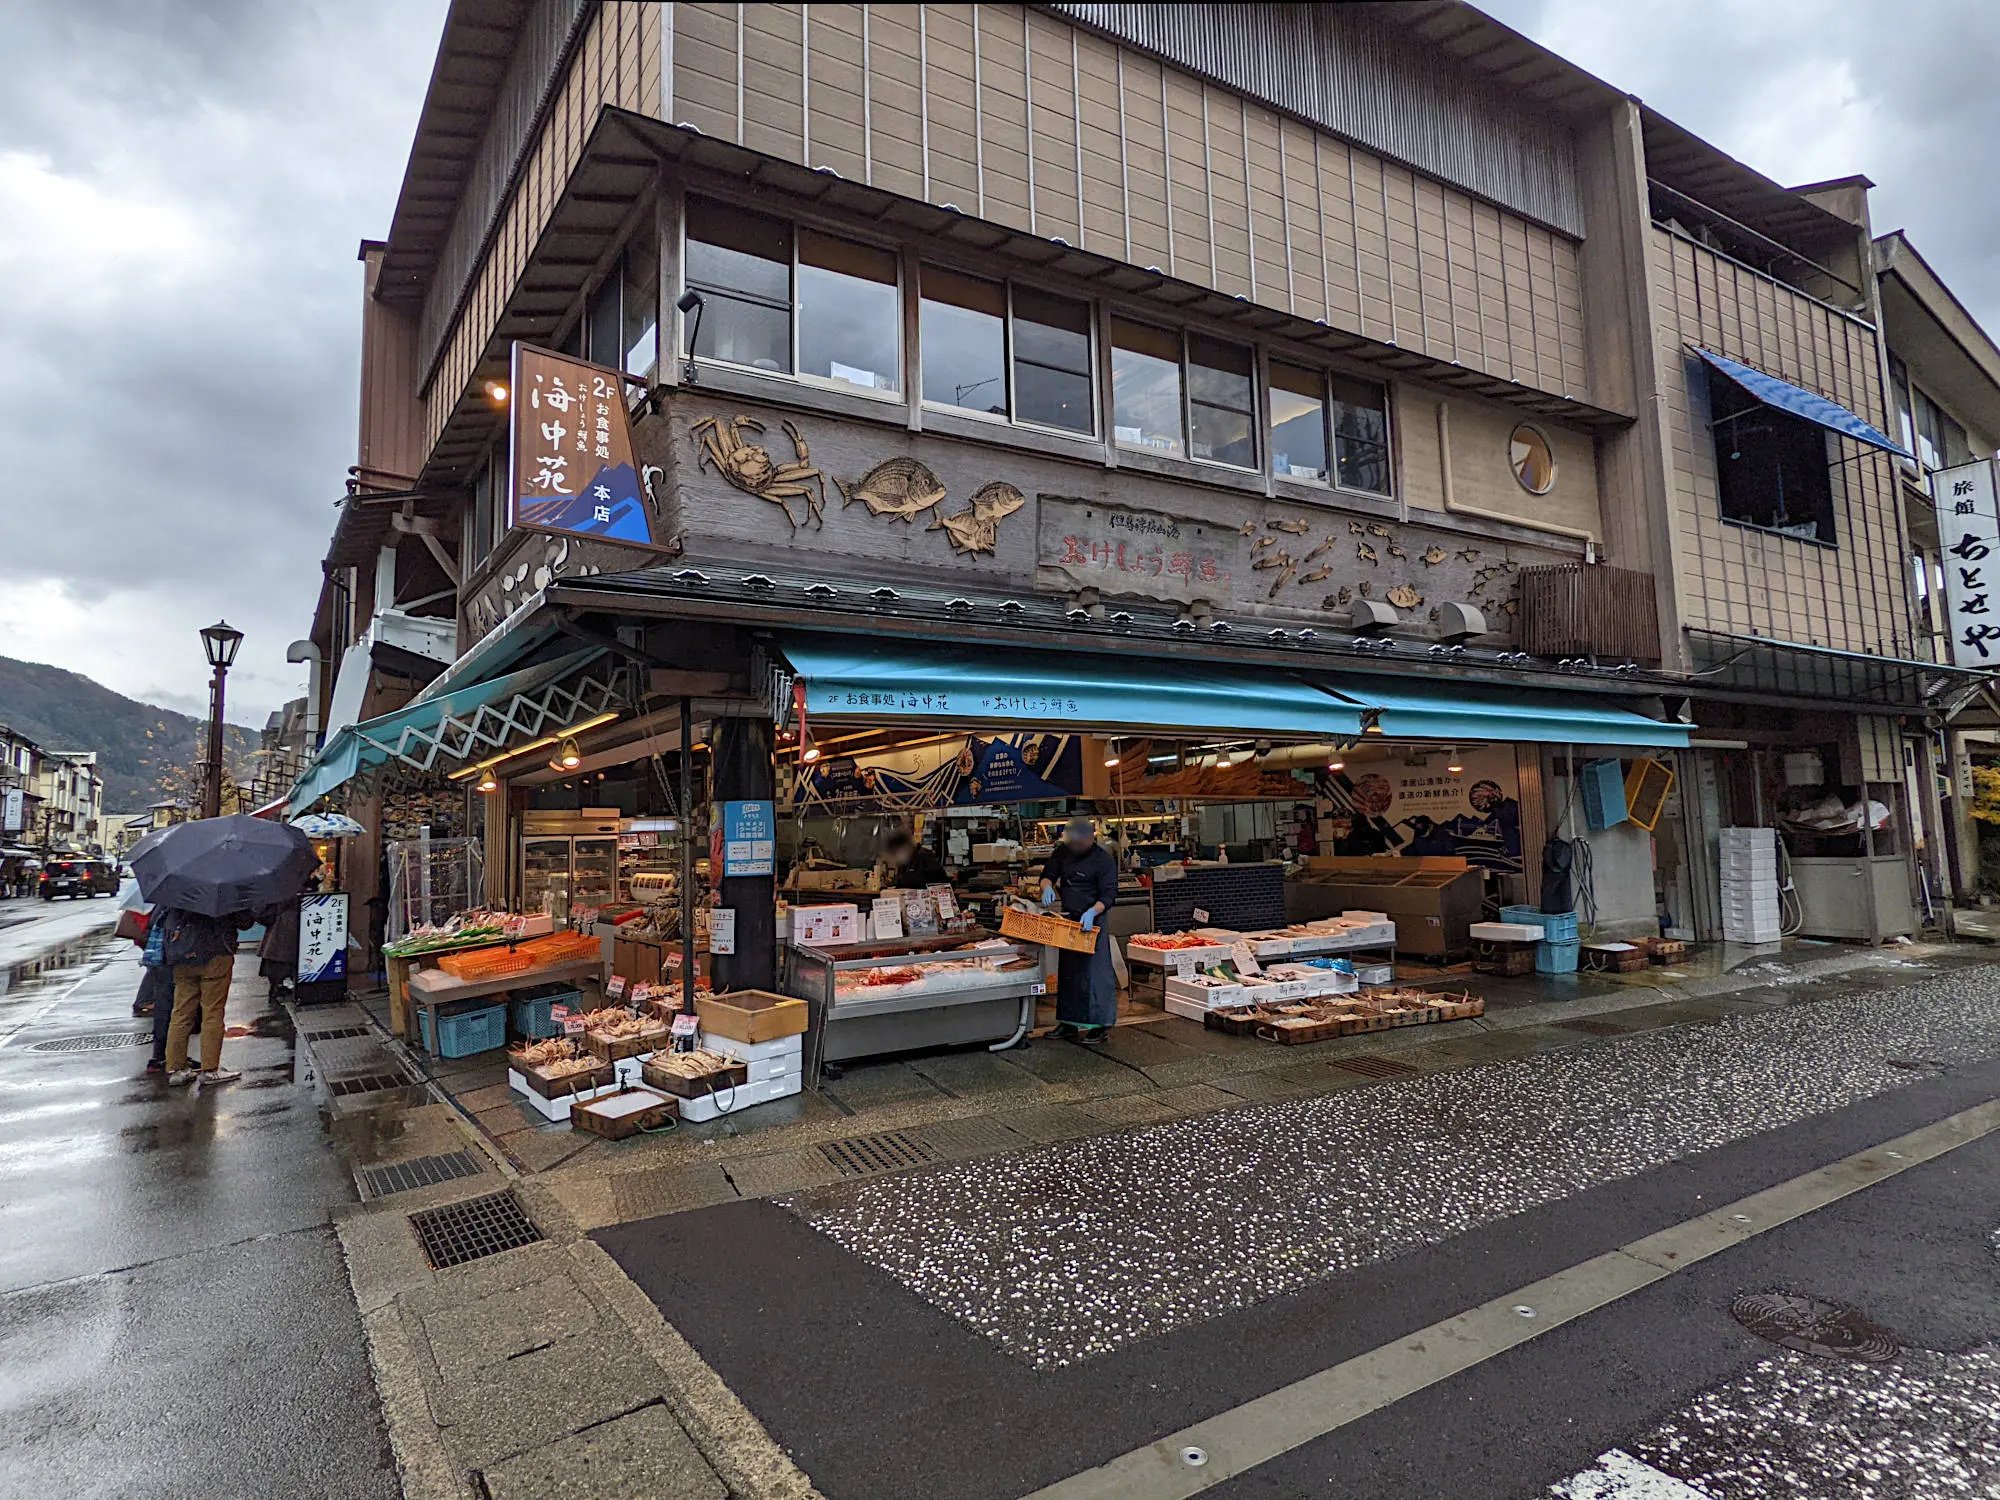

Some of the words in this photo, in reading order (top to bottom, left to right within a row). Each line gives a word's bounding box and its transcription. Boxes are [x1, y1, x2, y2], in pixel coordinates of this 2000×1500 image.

[592, 376, 616, 400] 2F
[531, 374, 577, 494] 海中苑
[594, 404, 610, 459] お食事処
[593, 485, 611, 523] 本店
[1953, 480, 1975, 516] 旅館
[1950, 533, 2000, 658] ちとせや
[828, 695, 839, 703] 2F
[846, 694, 895, 707] お食事処
[981, 700, 990, 709] 1F
[331, 898, 344, 907] 2F
